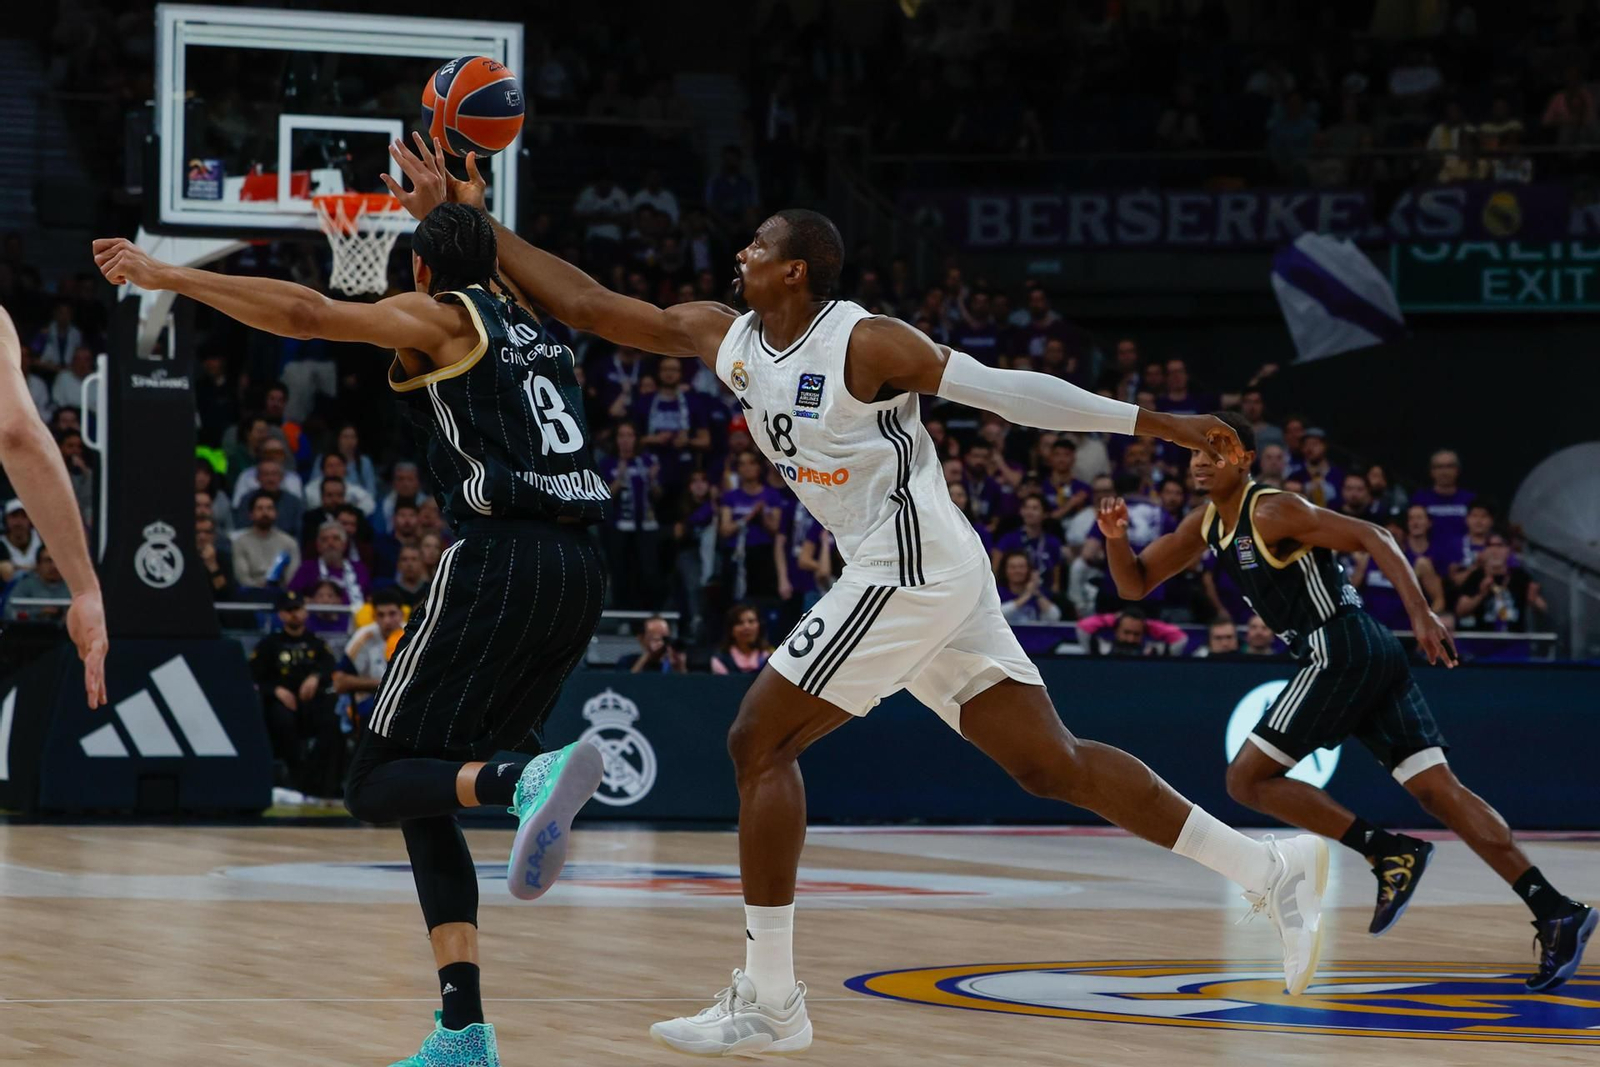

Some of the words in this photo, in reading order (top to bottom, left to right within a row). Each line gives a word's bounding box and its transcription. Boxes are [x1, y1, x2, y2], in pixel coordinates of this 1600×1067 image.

[1483, 267, 1594, 301] EXIT
[523, 371, 584, 456] 13
[763, 410, 797, 457] 18
[525, 820, 562, 889] RARE
